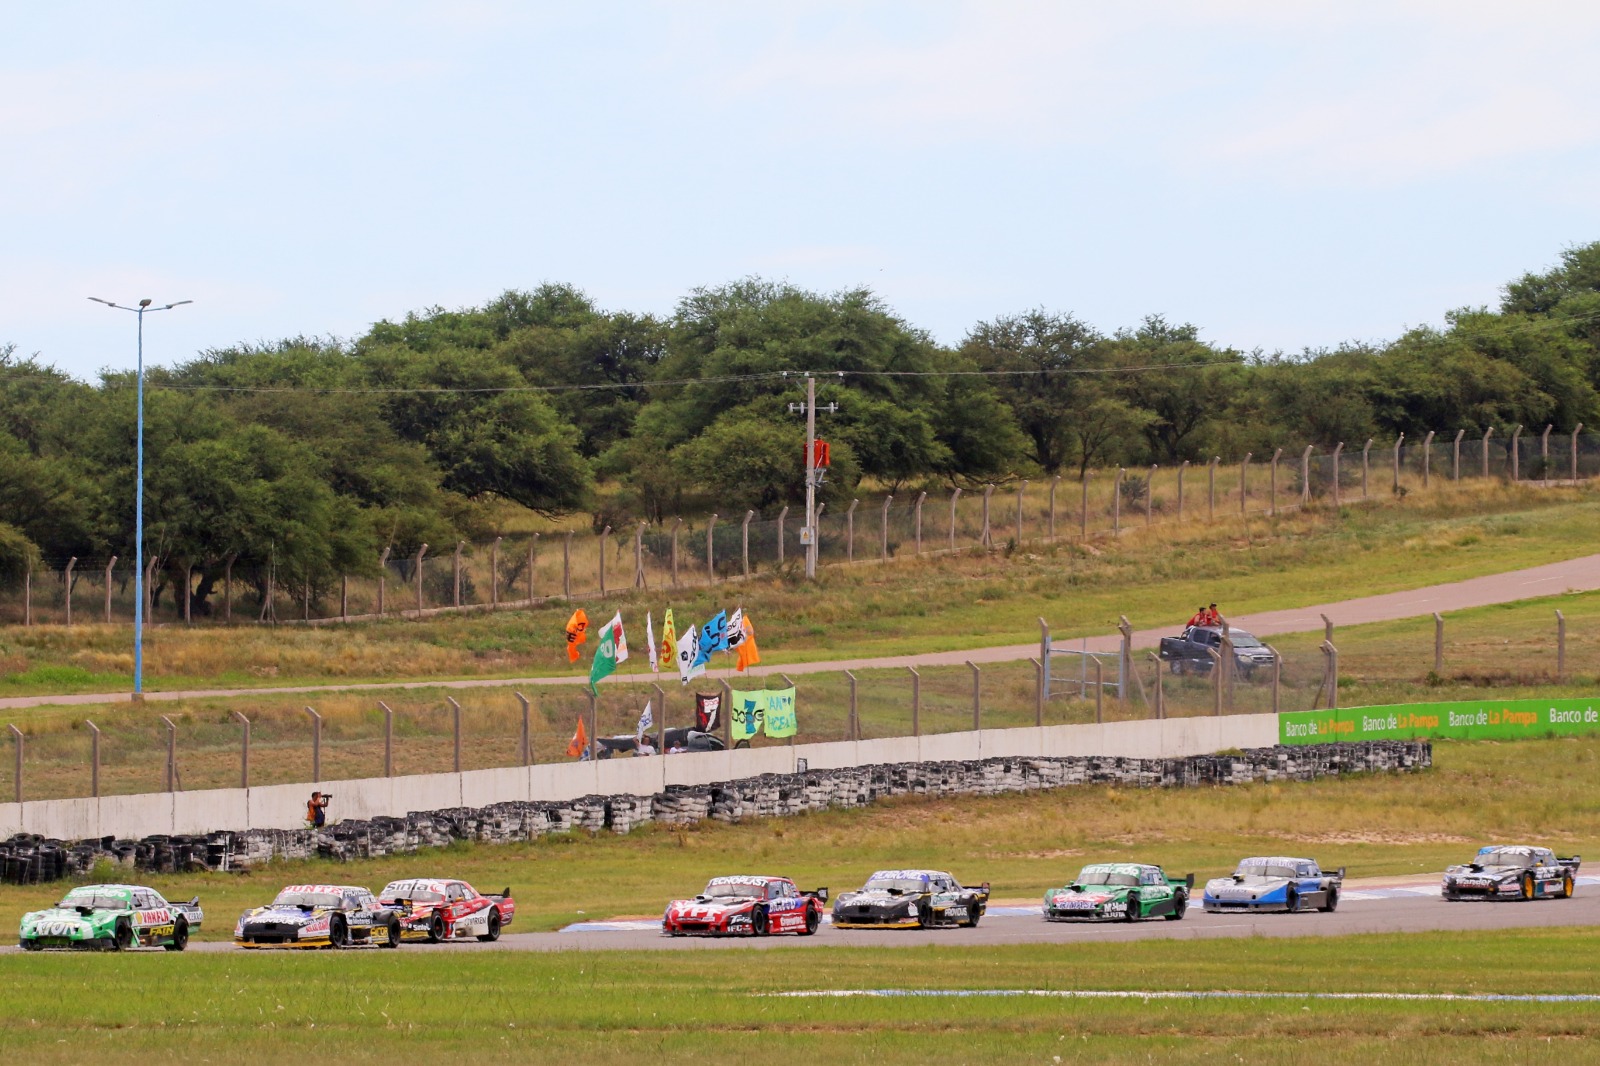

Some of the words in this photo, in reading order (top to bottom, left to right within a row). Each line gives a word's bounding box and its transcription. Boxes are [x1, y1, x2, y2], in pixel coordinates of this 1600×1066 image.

[1363, 716, 1385, 731] Banco
[1387, 713, 1397, 729] de
[1398, 714, 1407, 728] La
[1409, 713, 1439, 730] Pampa
[1449, 711, 1474, 726] Banco
[1476, 708, 1487, 725] de
[1489, 710, 1500, 724] La
[1503, 709, 1537, 727] Pampa
[1550, 708, 1581, 723] Banco
[1584, 706, 1598, 722] de
[1286, 722, 1306, 736] Banco
[1309, 720, 1317, 735] de
[1318, 720, 1327, 734] La
[1329, 719, 1354, 736] Pampa
